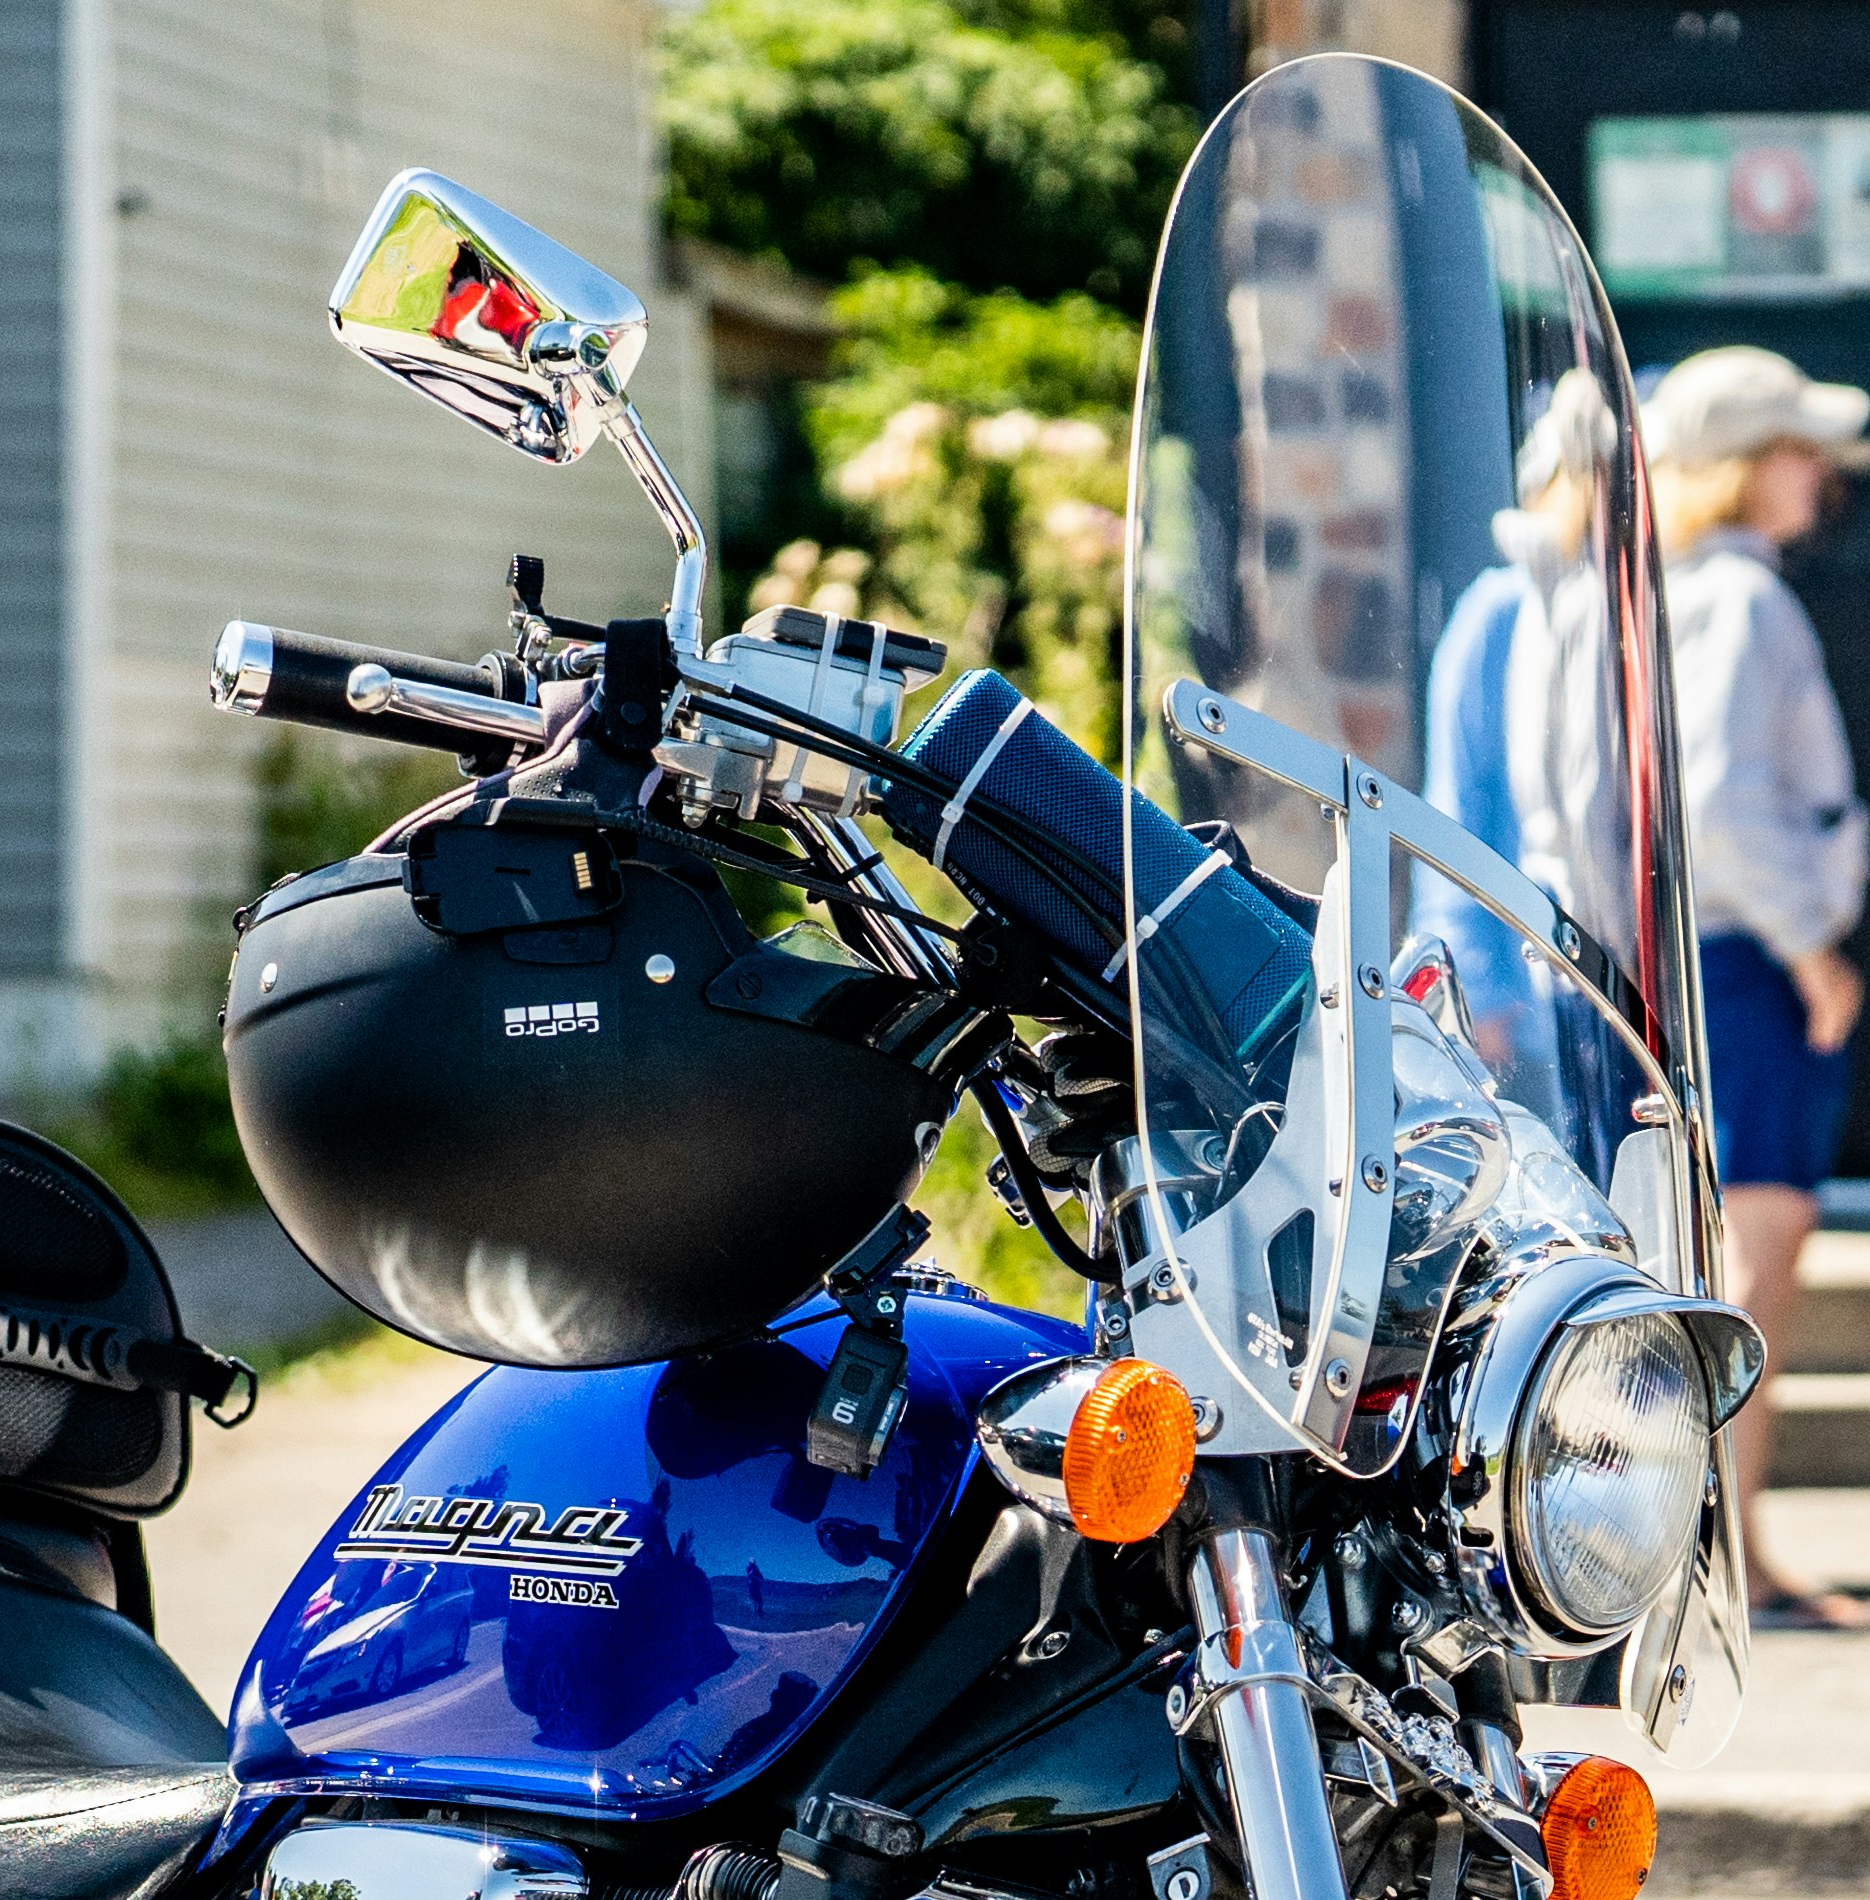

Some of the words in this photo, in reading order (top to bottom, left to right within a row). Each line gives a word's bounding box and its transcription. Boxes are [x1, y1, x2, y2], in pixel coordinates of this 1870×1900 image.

[505, 1017, 601, 1037] GoPro
[334, 1484, 643, 1576] Magna
[510, 1575, 619, 1608] HONDA
